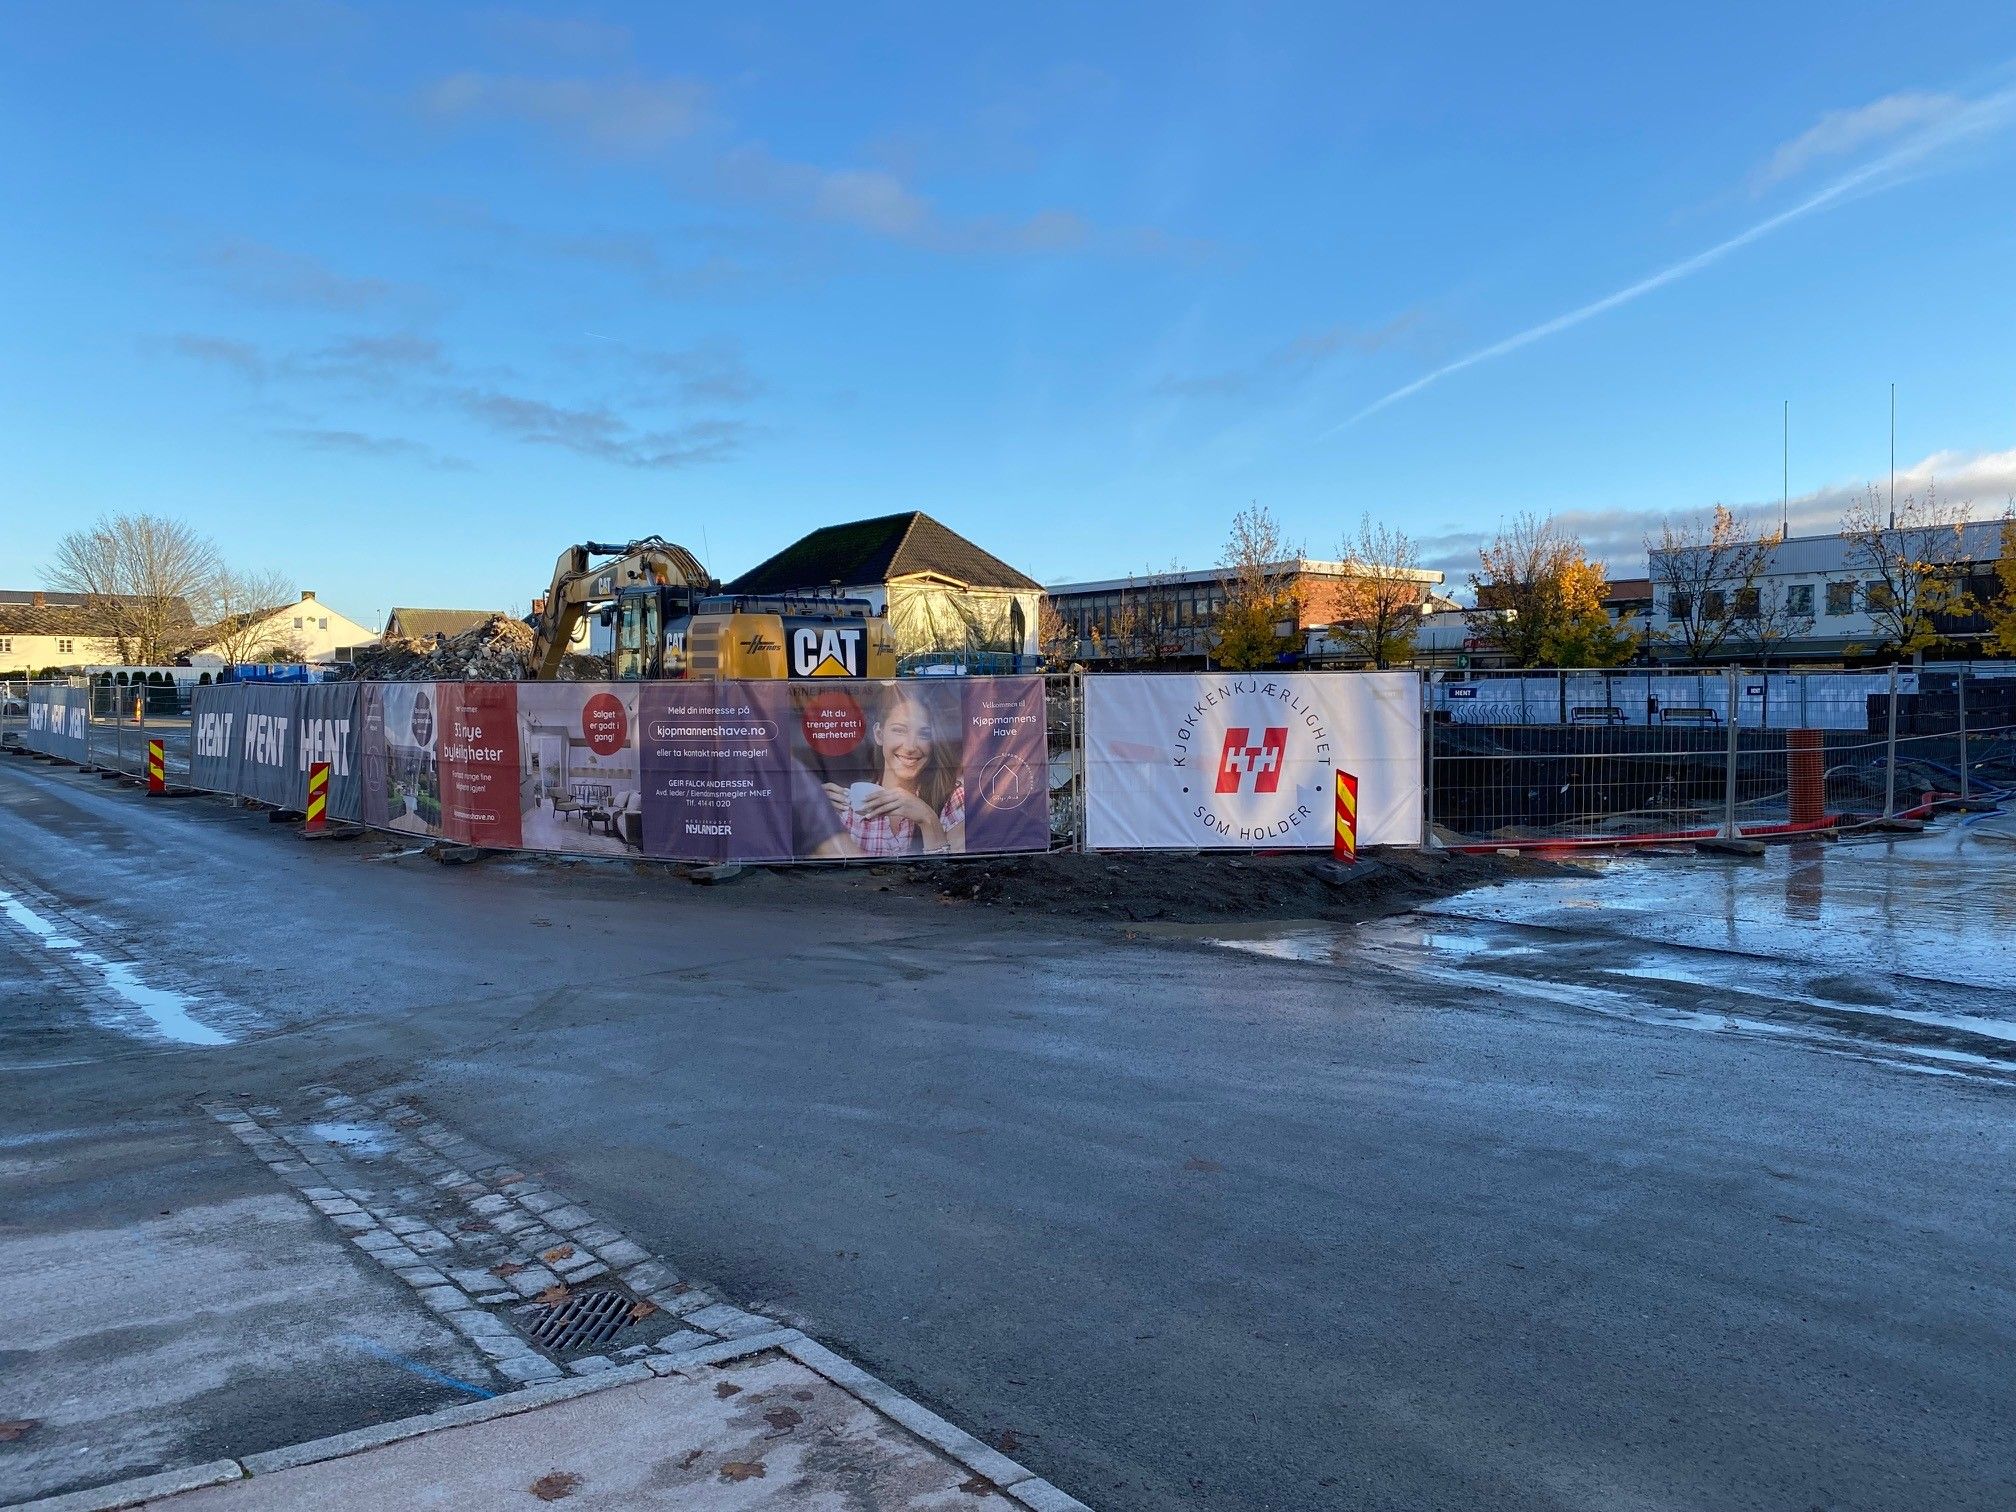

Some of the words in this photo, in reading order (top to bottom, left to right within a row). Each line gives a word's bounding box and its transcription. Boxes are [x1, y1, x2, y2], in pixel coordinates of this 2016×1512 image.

[599, 577, 611, 595] CAT
[667, 632, 684, 655] CAT
[793, 628, 860, 677] CAT
[668, 706, 685, 715] Meld
[687, 706, 698, 715] din
[699, 706, 735, 715] interesse
[738, 706, 750, 716] på
[821, 710, 833, 718] Alt
[806, 721, 838, 729] trenger
[840, 720, 857, 728] rett
[972, 715, 1037, 727] Kjøpmannens
[1173, 681, 1332, 768] KJØKKENKJÆRLIGHET
[590, 722, 597, 730] er
[599, 722, 616, 731] godt
[657, 725, 766, 738] kjopmannenshave.no
[812, 731, 856, 739] nærheten!
[993, 728, 1018, 736] Have
[198, 712, 234, 758] HENT
[245, 713, 288, 768] HENT
[300, 718, 350, 777] HENT
[656, 749, 671, 757] eller
[673, 749, 681, 757] ta
[684, 749, 710, 757] kontakt
[711, 749, 730, 757] med
[733, 749, 768, 759] megler!
[668, 779, 684, 787] GEIR
[706, 780, 754, 788] ANDERSSEN
[749, 789, 772, 797] MNEF
[716, 800, 731, 808] 020
[1193, 806, 1230, 836] SOM
[1240, 805, 1312, 841] HOLDER
[685, 824, 732, 835] NYLANDER
